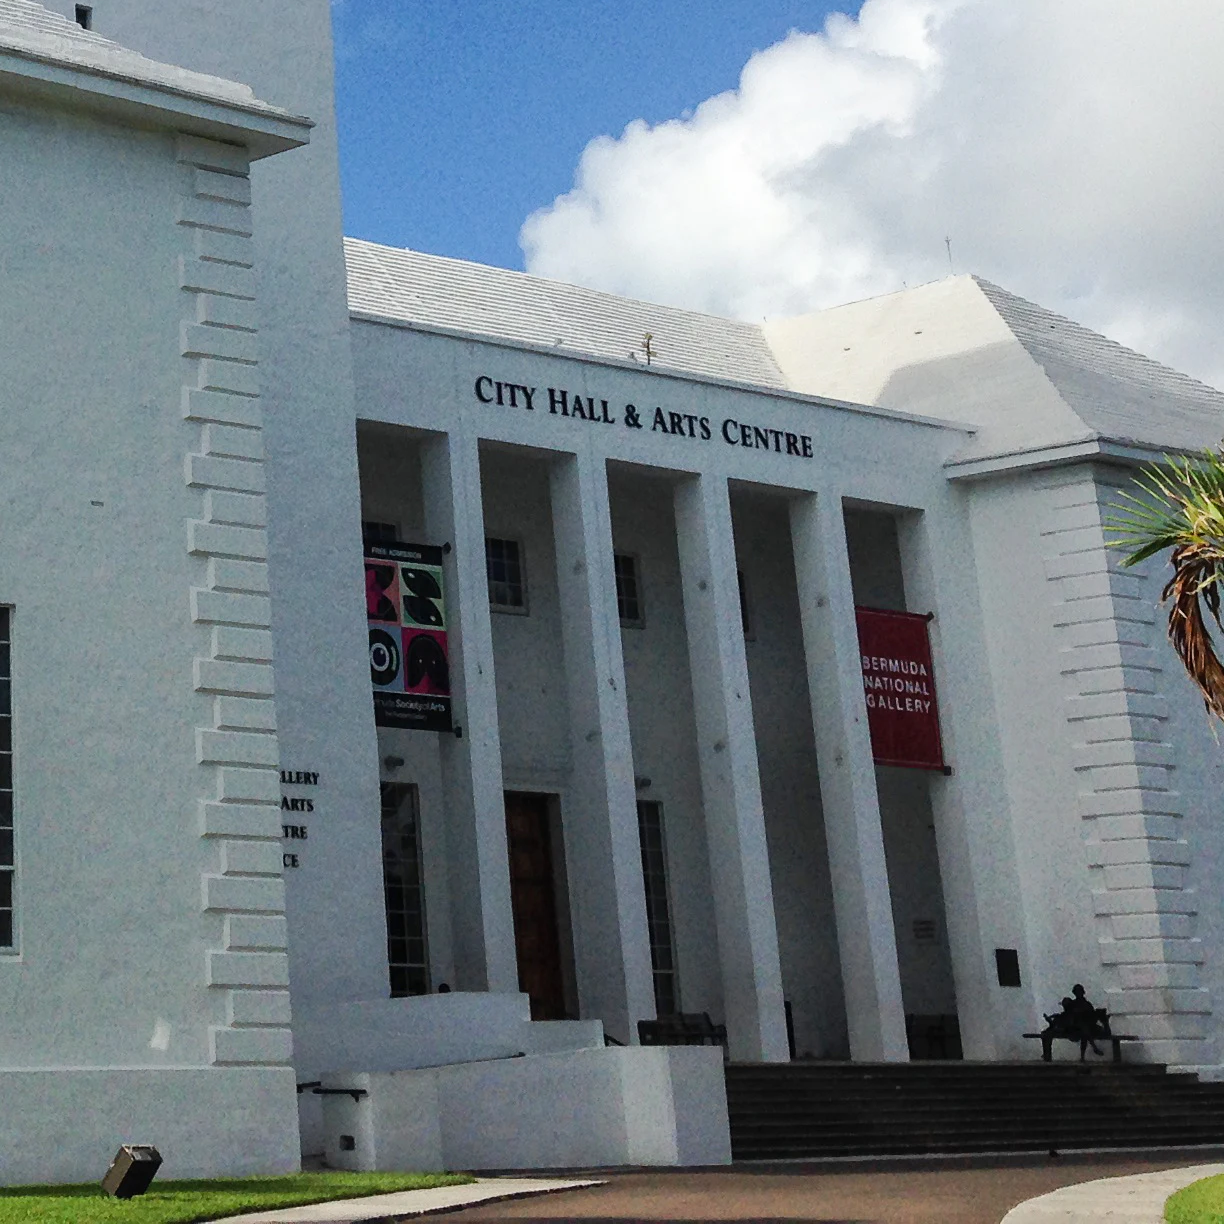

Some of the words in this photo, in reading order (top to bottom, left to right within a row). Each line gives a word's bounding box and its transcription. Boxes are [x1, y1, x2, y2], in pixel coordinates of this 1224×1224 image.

[475, 376, 536, 410] CITY
[547, 388, 615, 424] HALL
[624, 404, 643, 429] &
[651, 406, 712, 440] ARTS
[721, 419, 814, 458] CENTRE
[862, 655, 928, 676] BERMUDA
[864, 675, 930, 696] NATIONAL
[866, 693, 931, 714] GALLERY
[279, 770, 320, 785] LLERY
[281, 796, 314, 812] ARTS
[282, 824, 308, 840] TRE
[283, 853, 299, 868] CE
